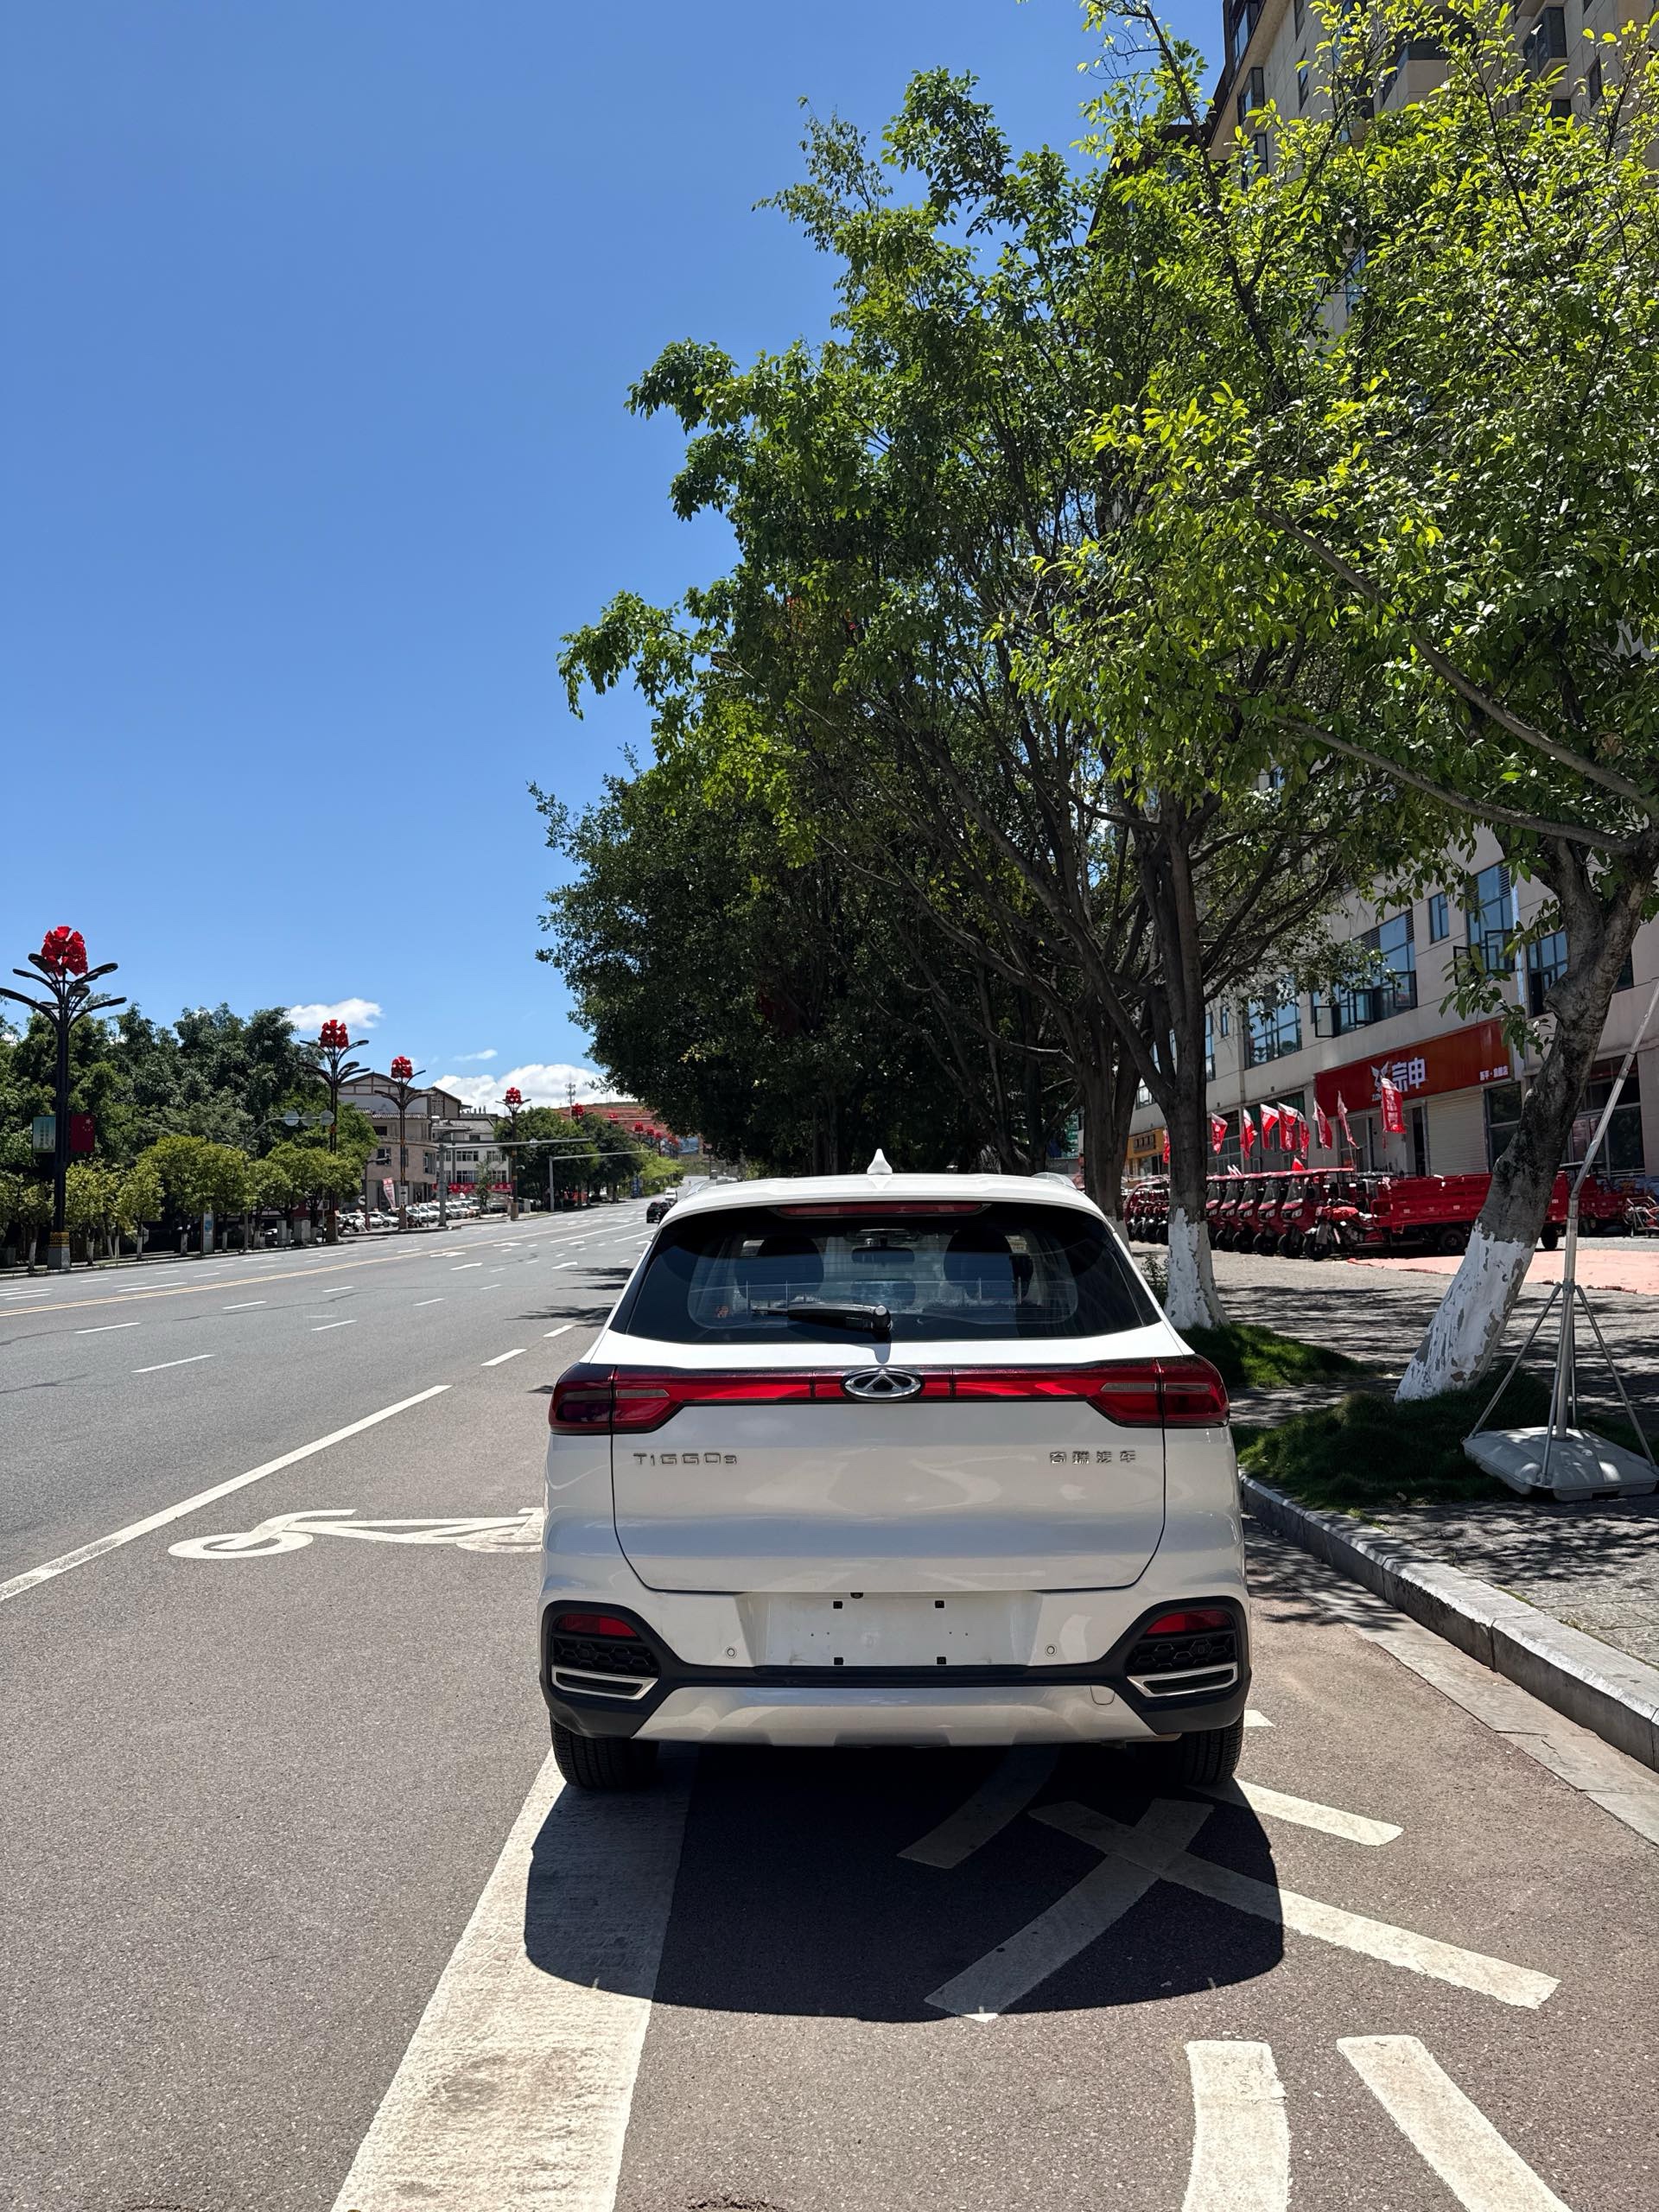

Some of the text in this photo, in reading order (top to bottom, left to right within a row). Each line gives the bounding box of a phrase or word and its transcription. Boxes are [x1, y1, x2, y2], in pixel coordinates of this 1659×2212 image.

[1391, 1057, 1426, 1092] 宗申
[1049, 1450, 1136, 1465] 奇瑞汽车
